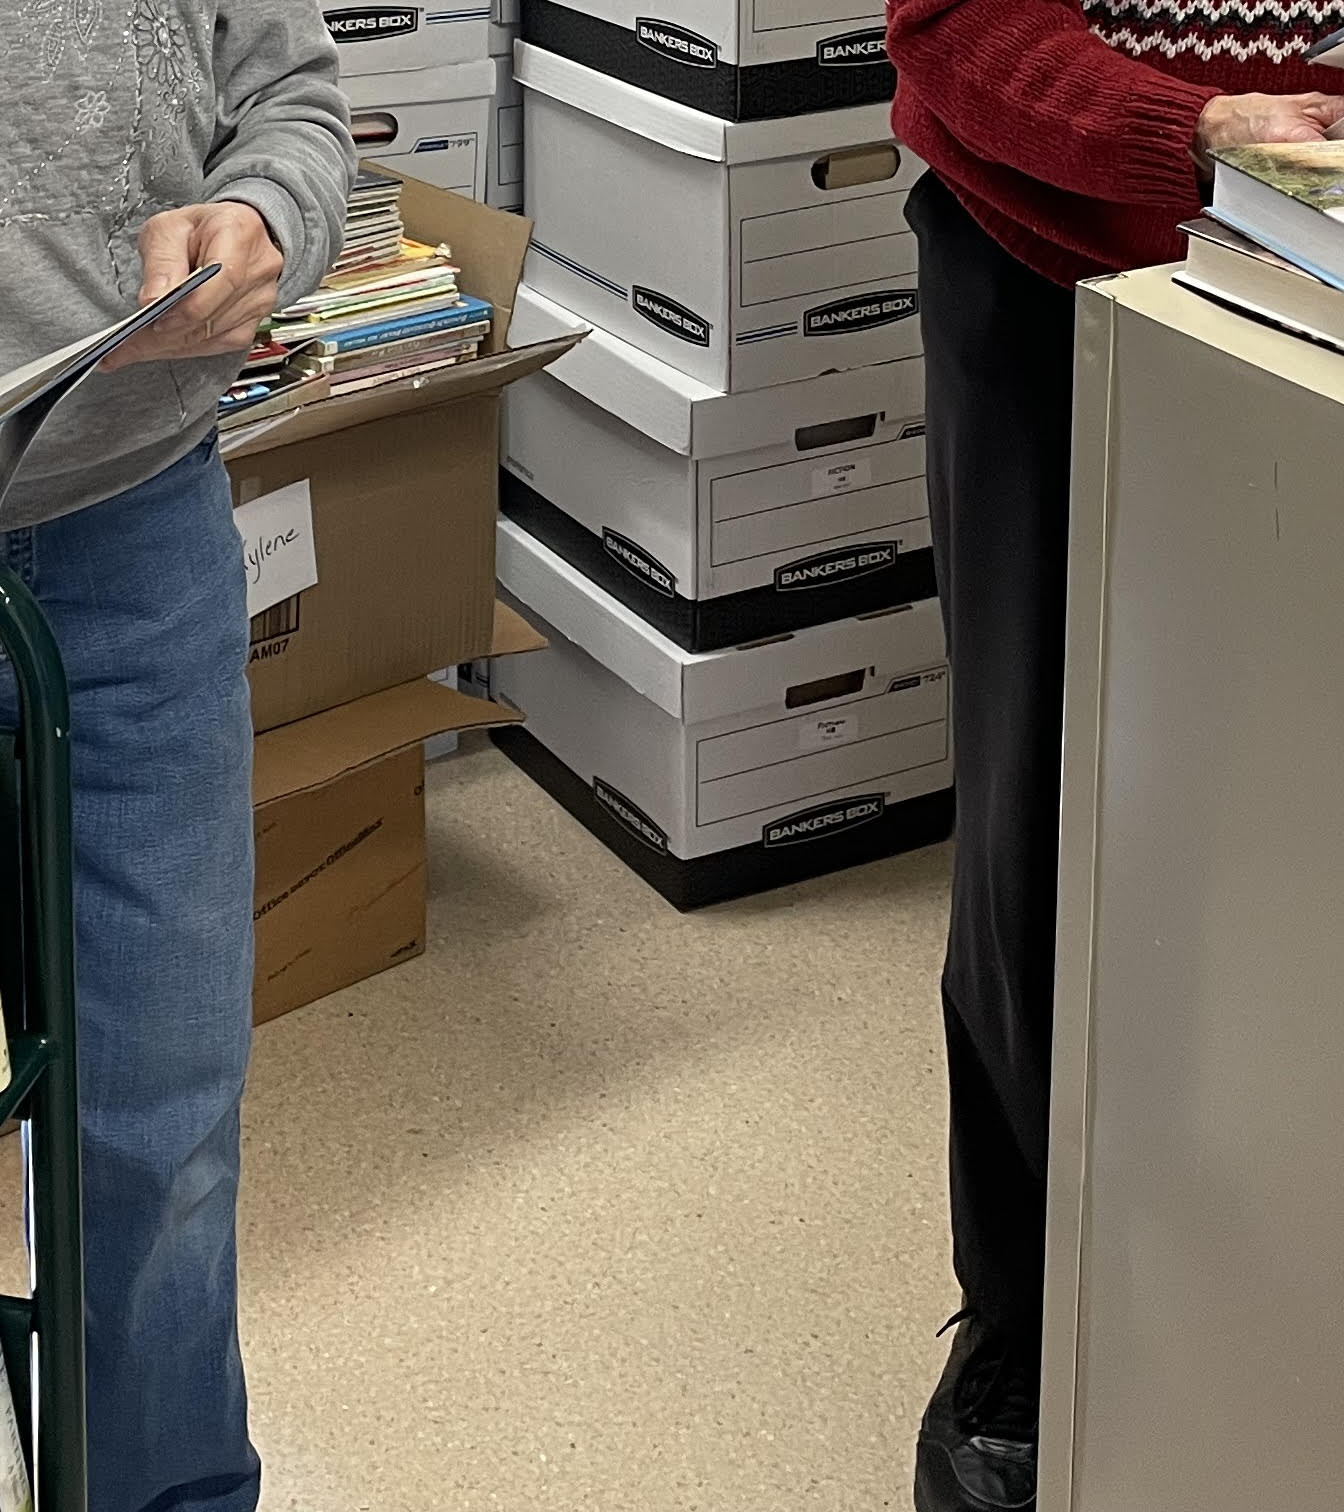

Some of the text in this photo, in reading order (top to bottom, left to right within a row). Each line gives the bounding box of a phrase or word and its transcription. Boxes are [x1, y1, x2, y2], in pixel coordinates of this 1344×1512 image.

[379, 14, 412, 28] BOX
[640, 27, 714, 61] BANKERS BOX
[636, 295, 705, 339] BANKERS BOX
[811, 296, 914, 328] BANKERS BOX
[244, 528, 300, 586] ylene
[606, 537, 671, 590] BANKERS BOX
[782, 549, 891, 585] BANKERS BOX
[769, 802, 879, 841] BANKERS BOX
